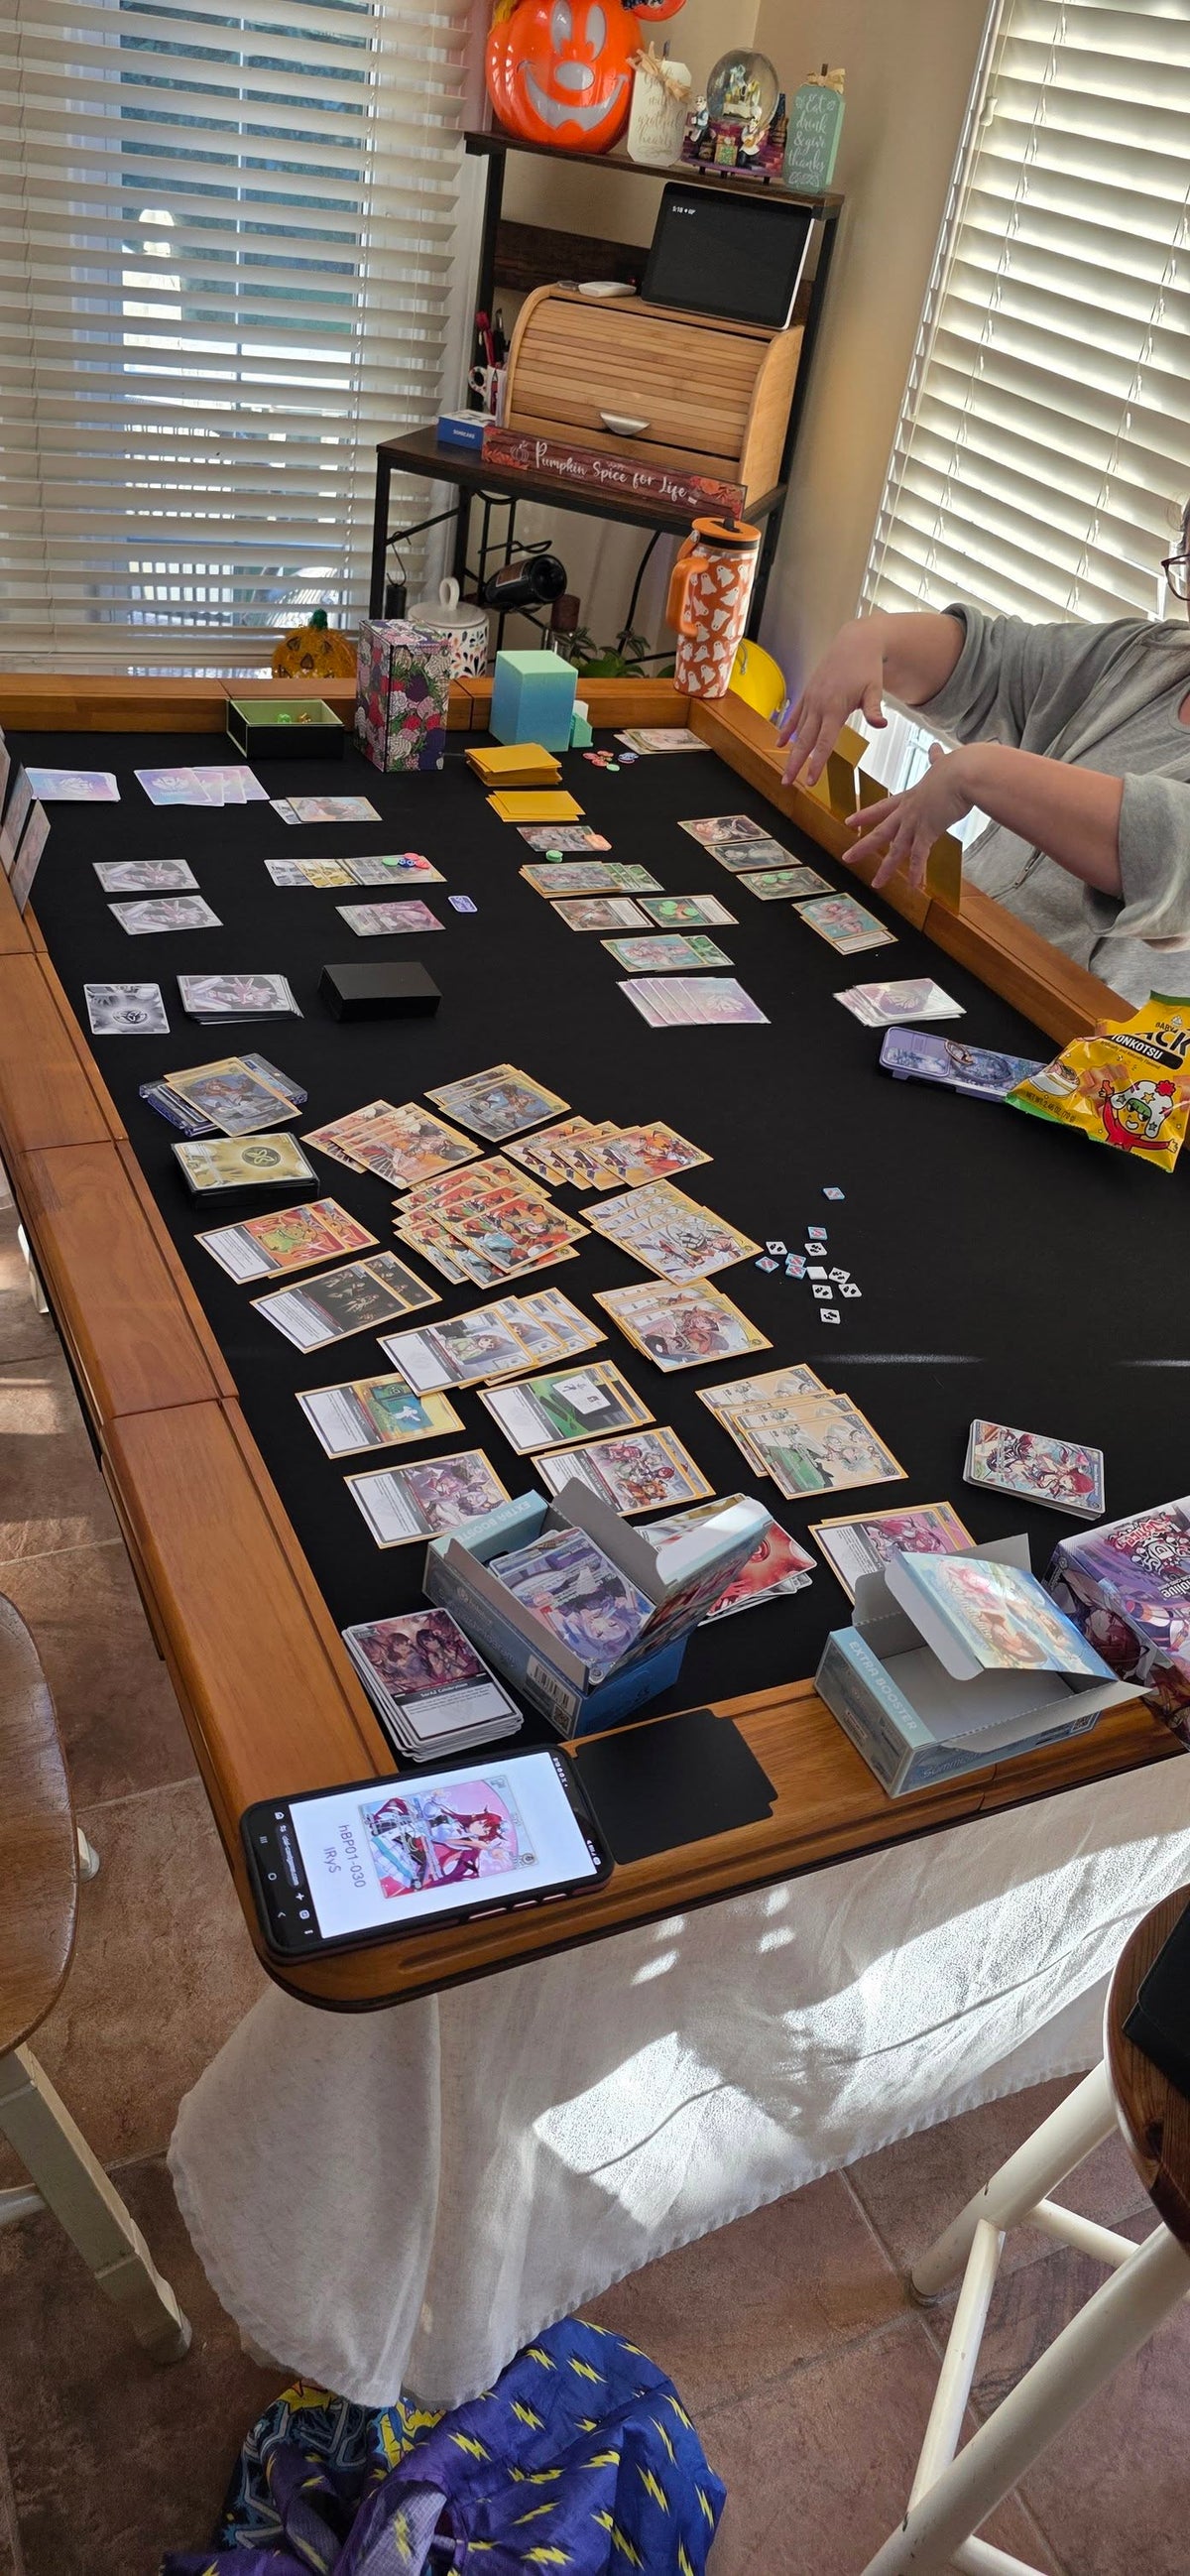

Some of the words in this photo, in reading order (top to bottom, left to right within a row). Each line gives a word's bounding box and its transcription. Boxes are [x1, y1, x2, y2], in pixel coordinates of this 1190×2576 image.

[805, 93, 826, 114] Eat
[796, 110, 827, 134] drink
[787, 148, 826, 173] thanks
[535, 440, 588, 476] Pumpkin
[593, 460, 629, 483] Spice
[632, 472, 657, 489] for
[658, 476, 687, 502] Life
[498, 1500, 532, 1522] EXTRA
[456, 1518, 497, 1542] BOOSTE
[1160, 1577, 1190, 1598] olive
[849, 1641, 879, 1676] EXTRA
[875, 1678, 917, 1730] BOOSTER
[339, 1824, 367, 1888] hBP01-030
